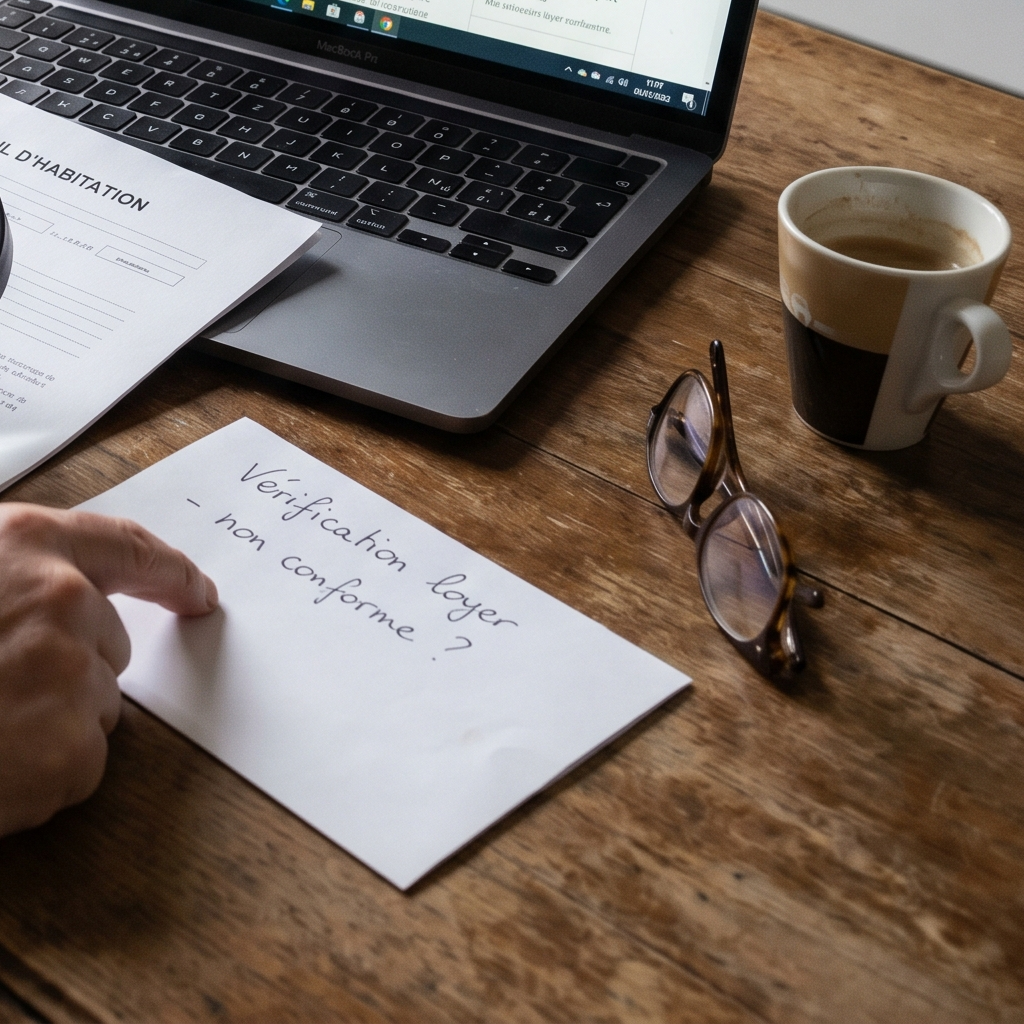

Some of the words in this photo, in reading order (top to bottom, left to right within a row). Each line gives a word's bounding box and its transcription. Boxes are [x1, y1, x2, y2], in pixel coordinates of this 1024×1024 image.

[105, 88, 117, 96] D
[238, 125, 252, 133] H
[331, 151, 344, 159] K
[121, 68, 133, 76] E
[209, 91, 220, 99] T
[297, 116, 310, 124] U
[147, 125, 160, 133] V
[237, 151, 251, 159] N
[14, 149, 150, 212] D'HABITATION
[240, 463, 406, 572] Vérification
[426, 574, 519, 626] loyer
[215, 513, 266, 551] non
[281, 556, 414, 642] conforme
[431, 636, 473, 662] ?
